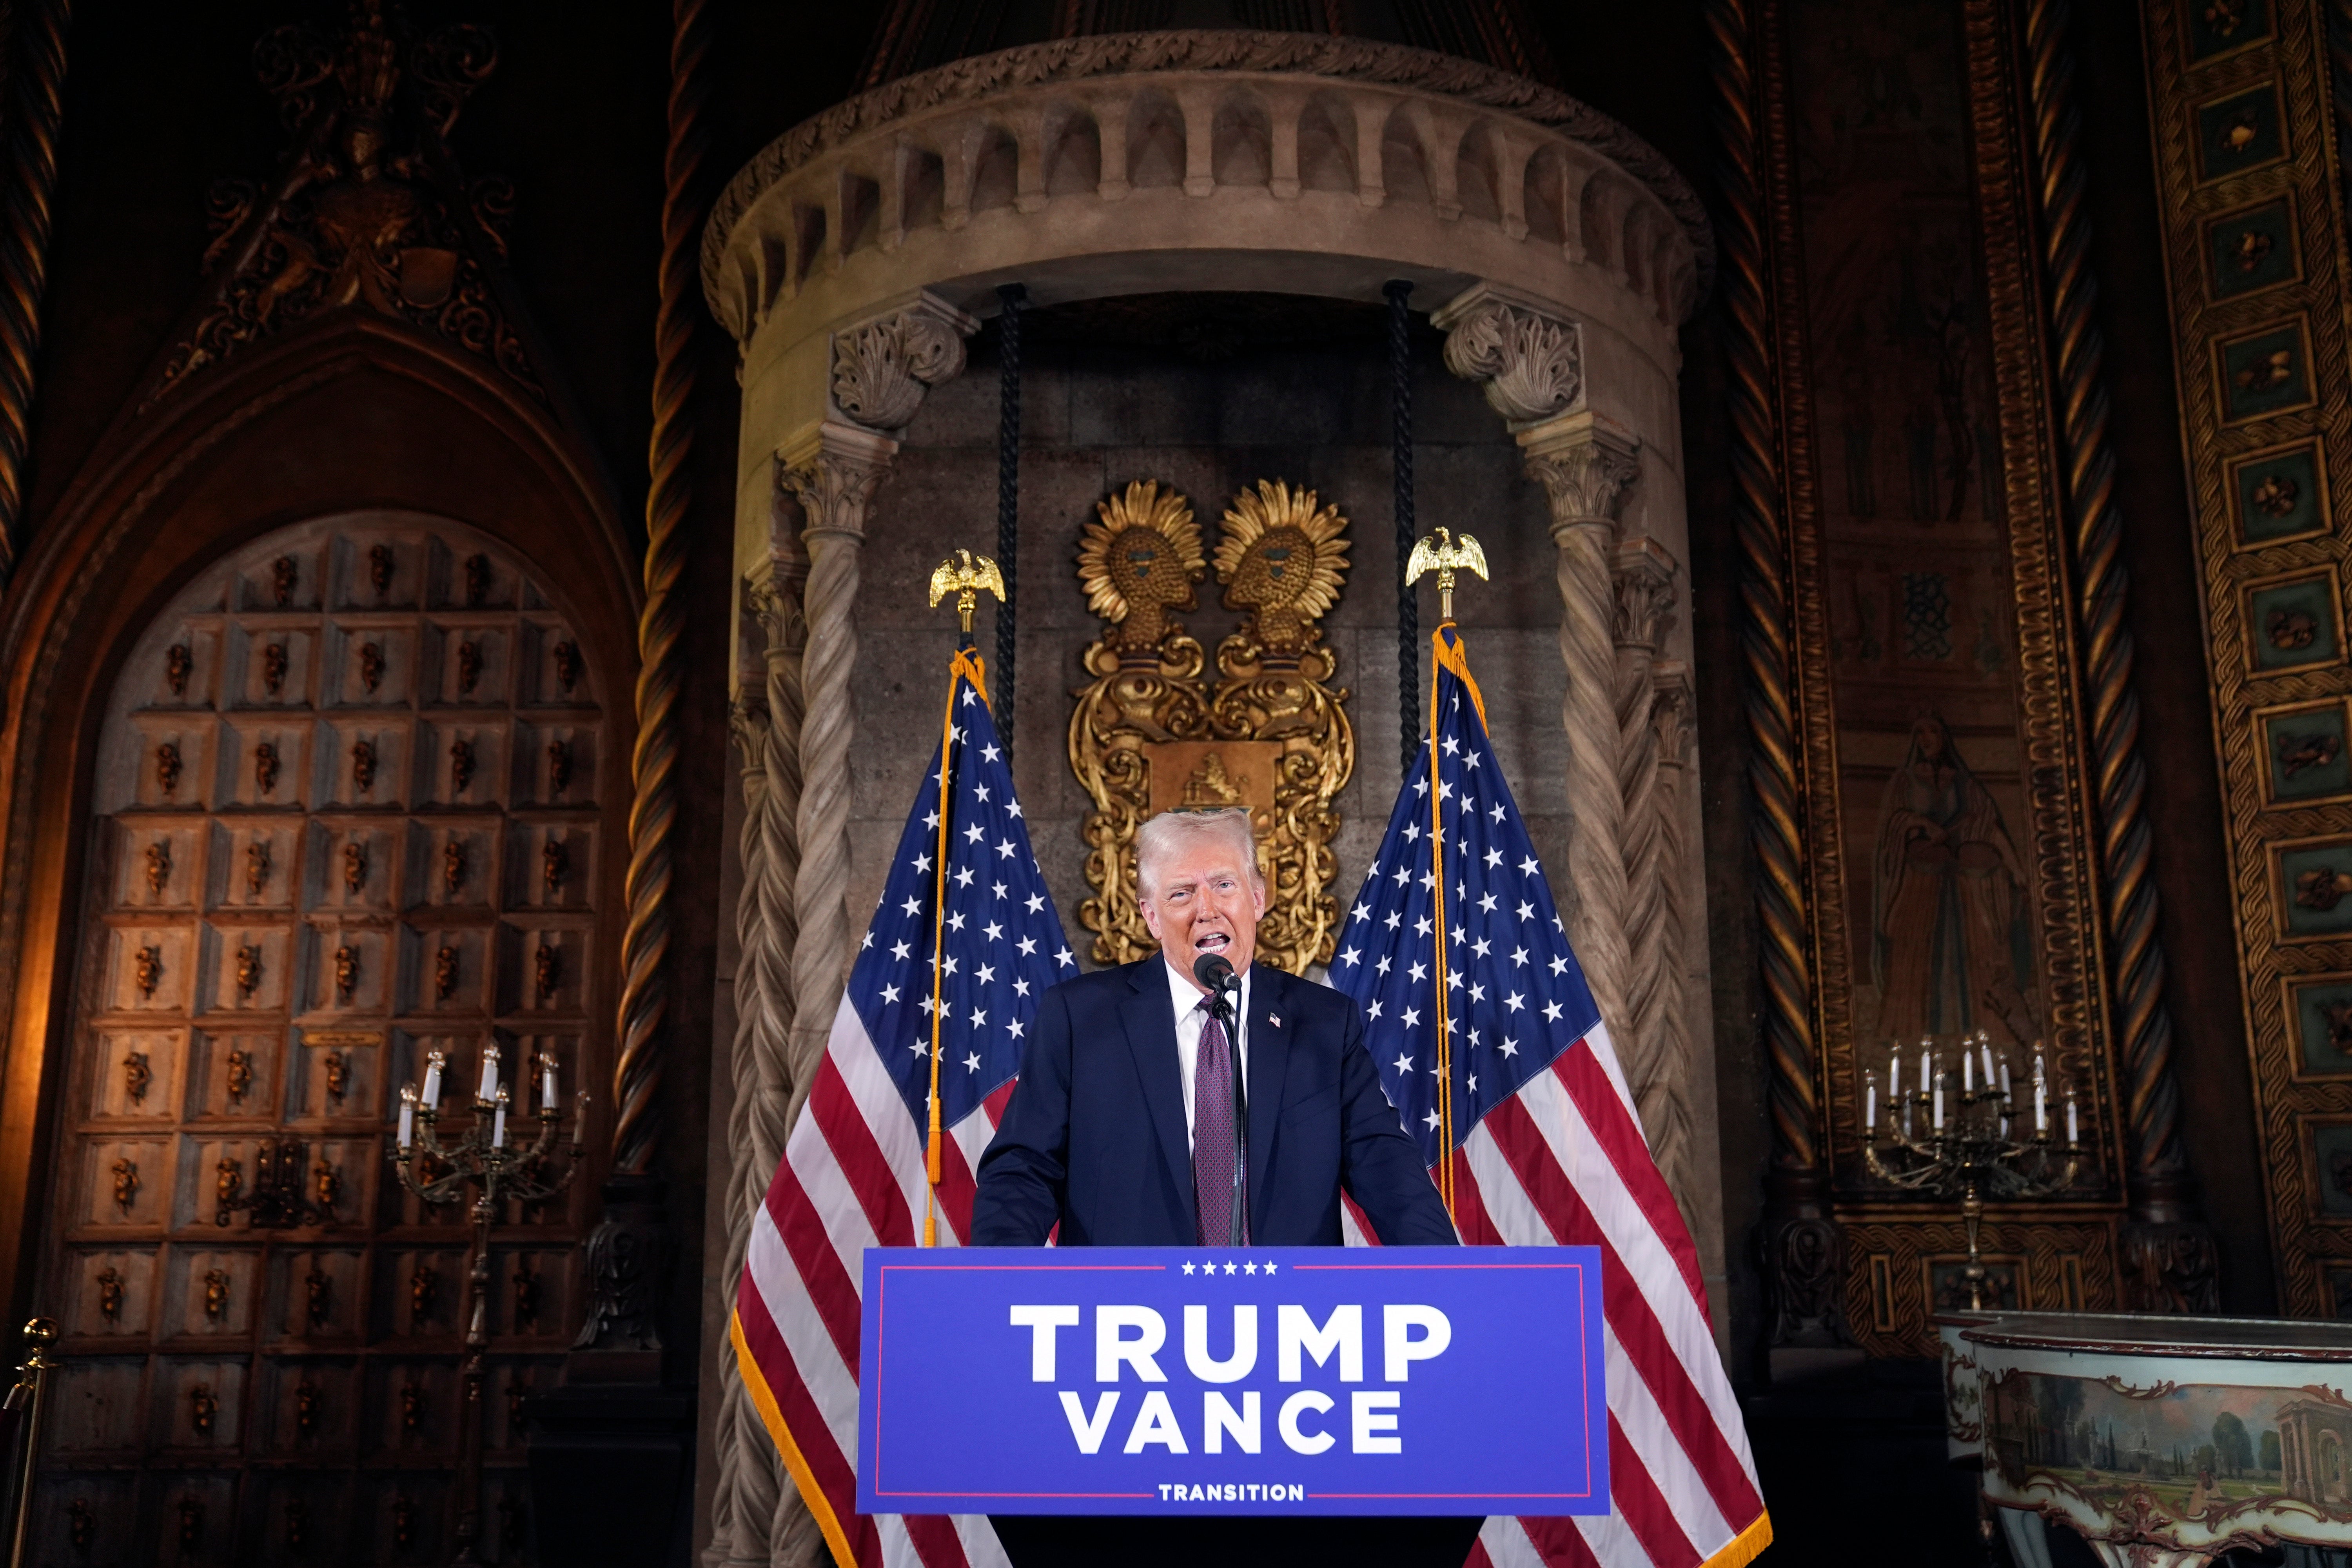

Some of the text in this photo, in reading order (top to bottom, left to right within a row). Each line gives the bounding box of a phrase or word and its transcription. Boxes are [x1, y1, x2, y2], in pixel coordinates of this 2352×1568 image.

[1010, 1304, 1452, 1383] TRUMP
[1058, 1390, 1402, 1455] VANCE
[1158, 1484, 1304, 1501] TRANSITION
